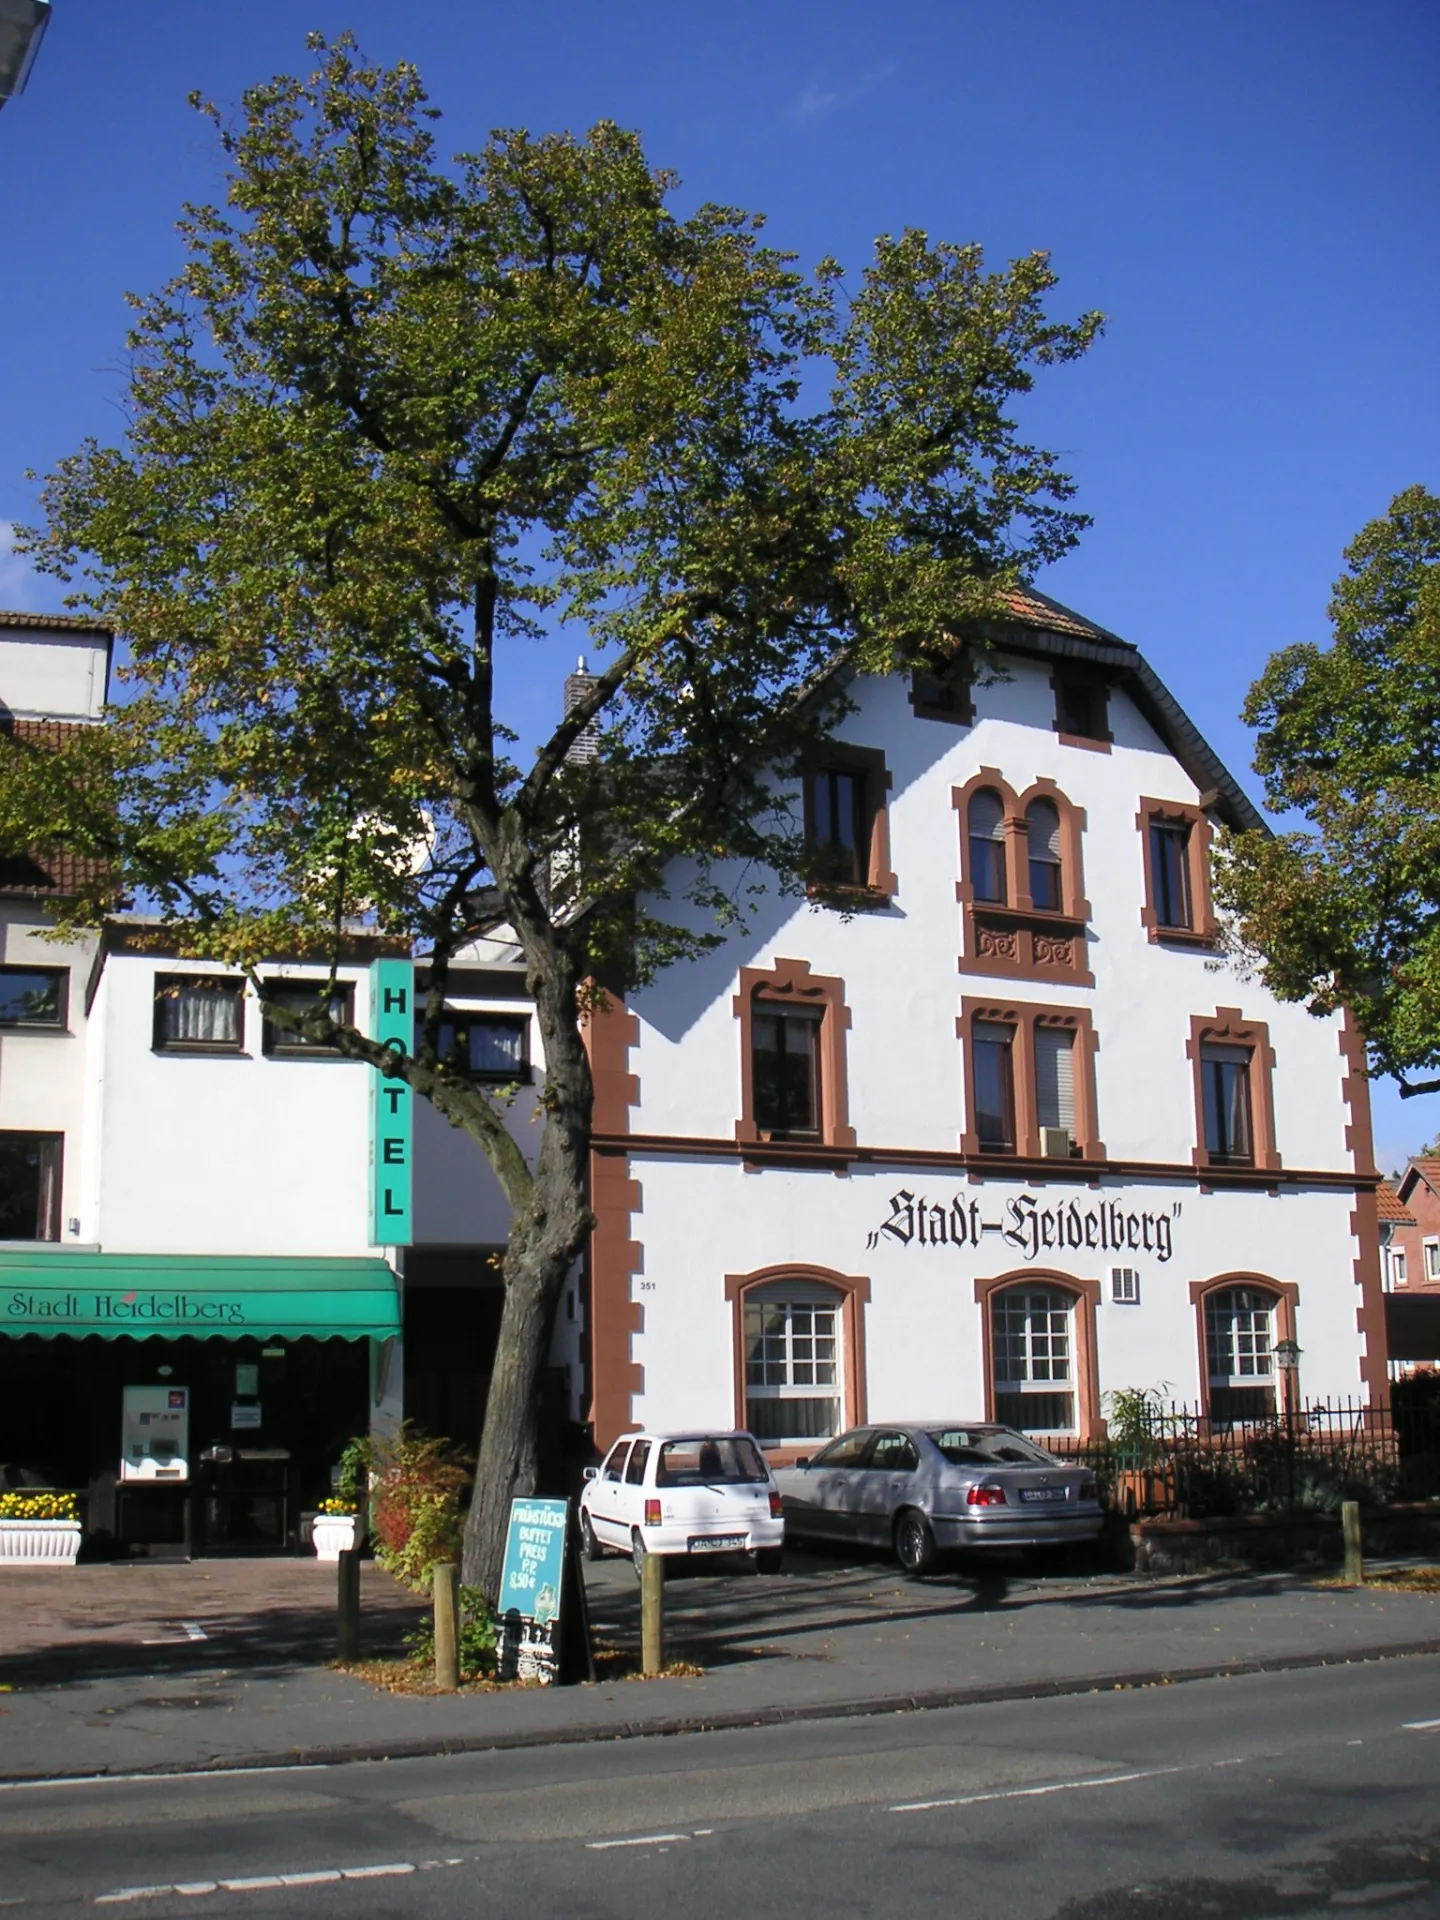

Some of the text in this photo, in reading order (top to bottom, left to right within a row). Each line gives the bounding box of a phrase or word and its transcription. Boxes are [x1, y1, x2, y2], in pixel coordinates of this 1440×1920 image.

[640, 1282, 656, 1290] 351
[8, 1293, 246, 1324] Stadt Heidelberg
[519, 1526, 553, 1546] BUFFET
[519, 1541, 547, 1562] PREIS
